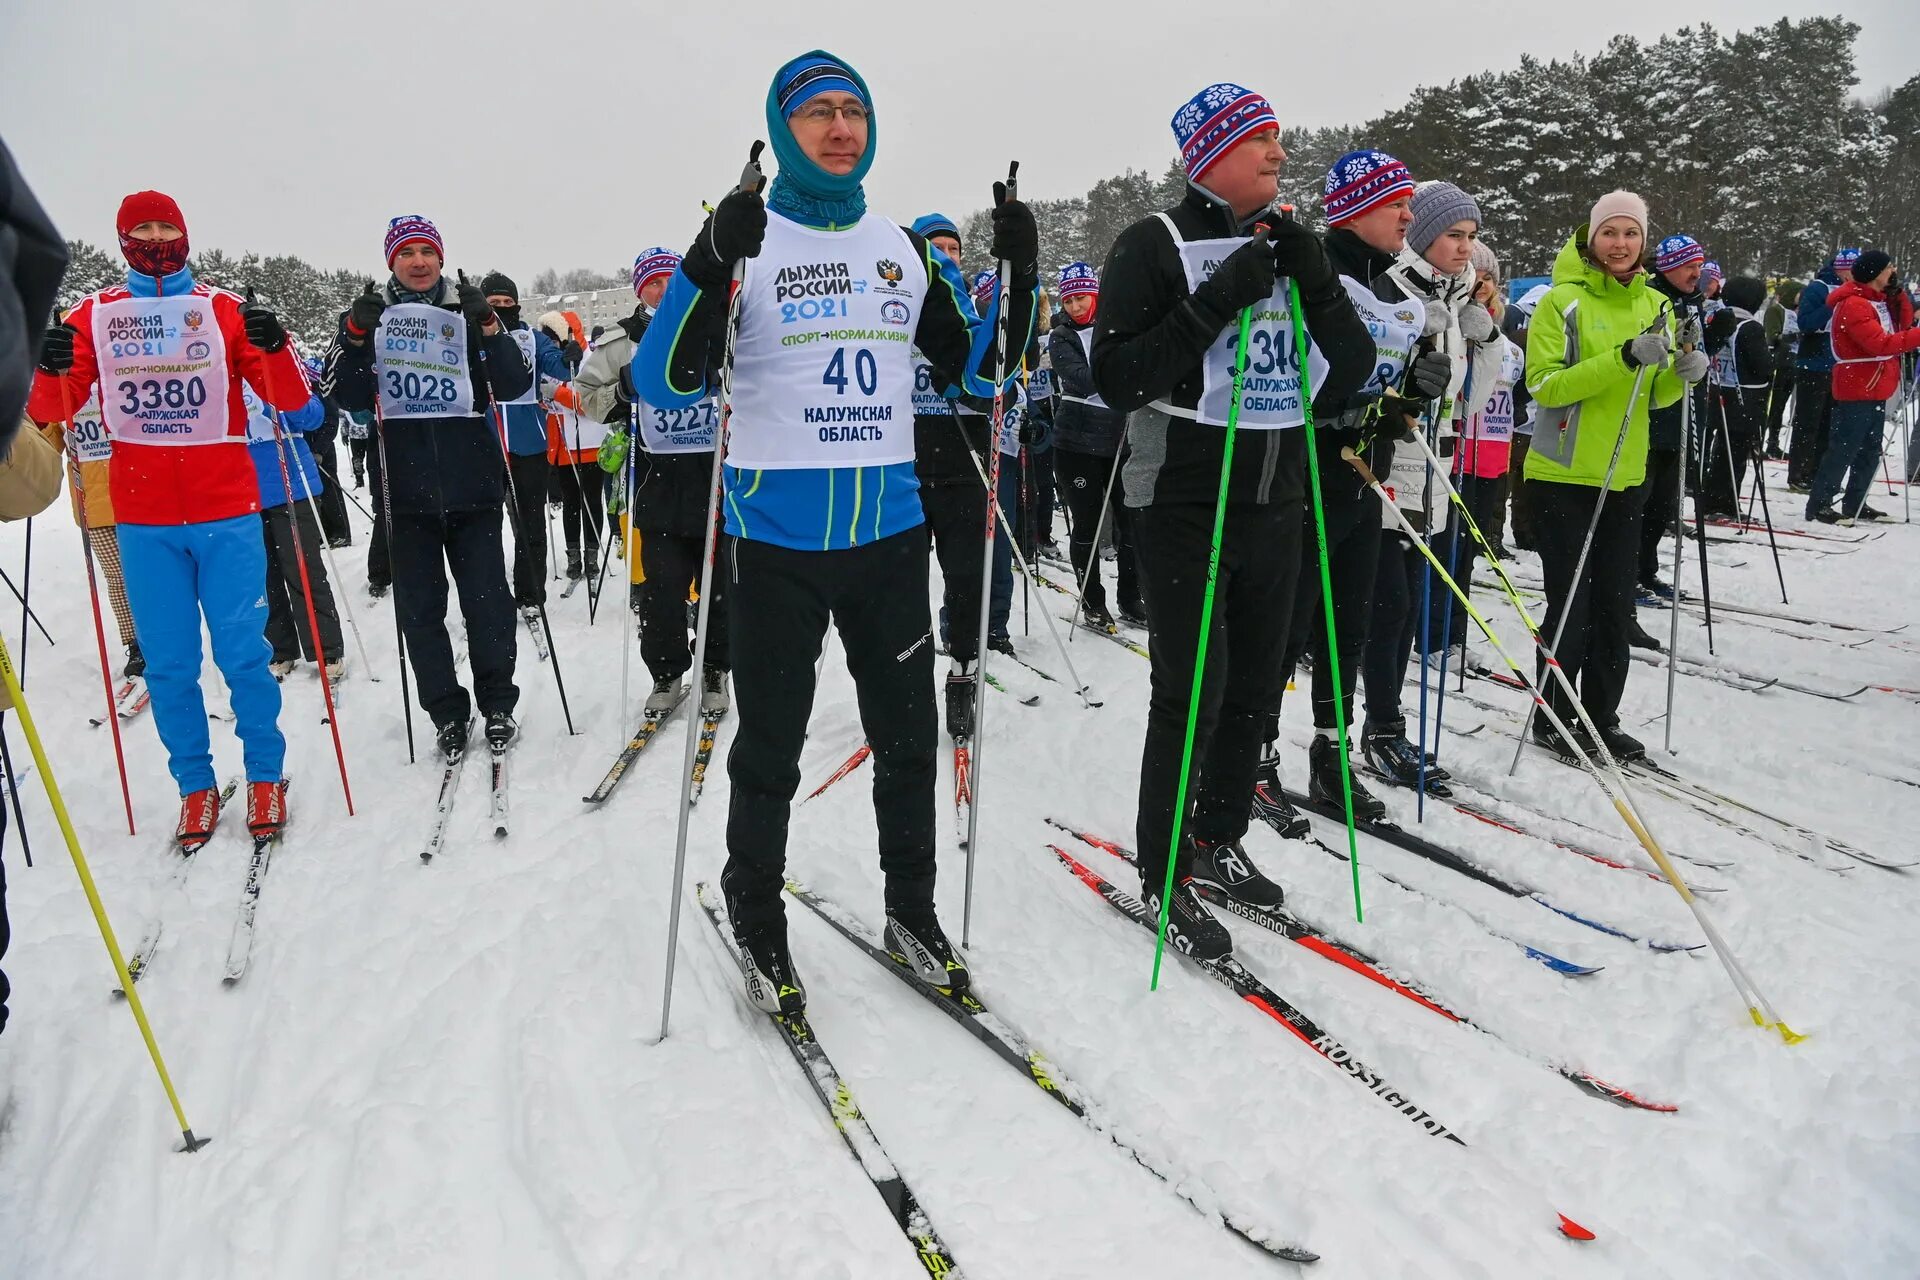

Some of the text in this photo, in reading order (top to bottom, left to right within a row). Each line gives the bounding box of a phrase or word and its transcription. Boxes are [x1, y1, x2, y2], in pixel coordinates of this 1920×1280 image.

[774, 263, 849, 285] ЛЫЖНЯ
[777, 279, 852, 302] РОССИИ
[780, 298, 847, 324] 2021
[107, 314, 163, 330] ЛЫЖНЯ
[387, 317, 428, 329] ЛЫЖНЯ
[109, 327, 165, 342] РОССИИ
[386, 327, 428, 340] РОССИИ
[781, 331, 821, 346] СПОРТ
[111, 341, 163, 358] 2021
[385, 338, 425, 354] 2021
[822, 347, 878, 396] 40
[386, 370, 458, 402] 3028
[118, 375, 207, 415] 3380
[1243, 396, 1298, 411] ОБЛАСТЬ
[405, 403, 448, 413] ОБЛАСТЬ
[804, 406, 892, 423] КАЛУЖСКАЯ
[653, 403, 714, 433] 3227
[141, 423, 193, 434] ОБЛАСТЬ
[819, 425, 883, 442] ОБЛАСТЬ
[672, 434, 712, 445] ОБЛАСТЬ
[629, 432, 637, 468] NORDWAY
[1227, 899, 1291, 938] ROSSIGNOL
[744, 946, 765, 1002] SCHER
